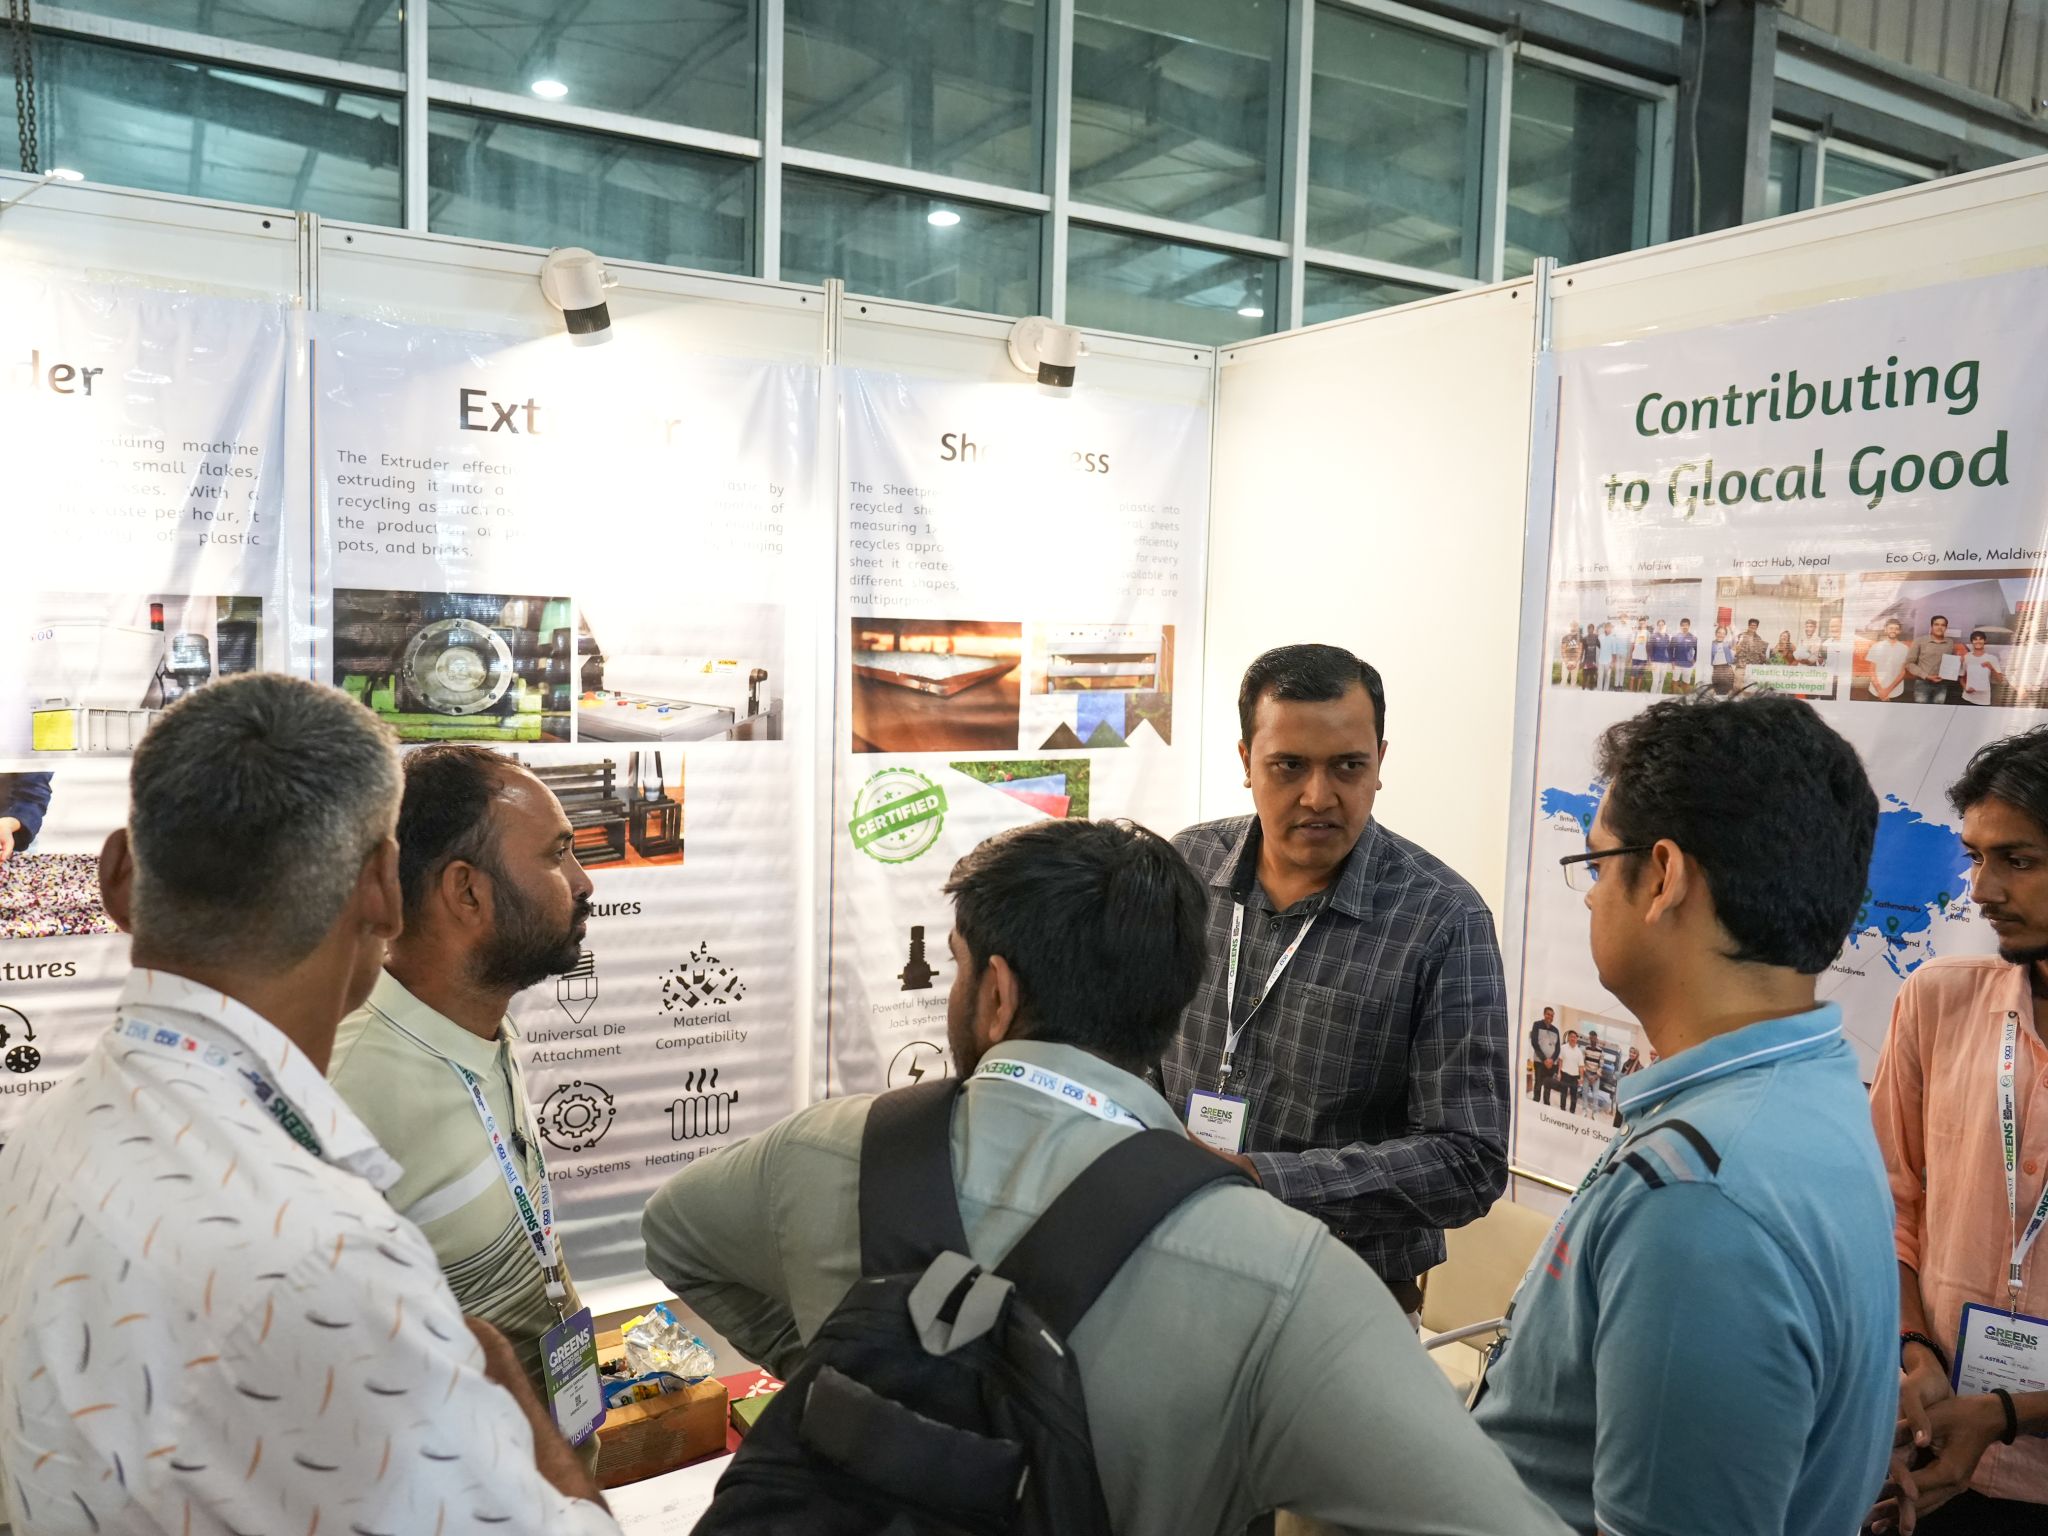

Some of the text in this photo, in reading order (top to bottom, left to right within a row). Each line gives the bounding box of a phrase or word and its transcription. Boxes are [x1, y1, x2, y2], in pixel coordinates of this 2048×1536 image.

[1635, 355, 1980, 437] Contributing
[183, 440, 259, 456] machine
[337, 450, 367, 464] The
[381, 454, 450, 471] Extruder
[132, 459, 187, 475] small
[199, 461, 259, 481] flakes,
[1604, 429, 2010, 521] to Glocal Good
[337, 474, 415, 493] extruding
[428, 479, 439, 492] it
[769, 483, 784, 497] by
[850, 482, 873, 494] The
[337, 496, 411, 514] recycling
[418, 503, 437, 513] as
[771, 503, 784, 514] of
[850, 502, 903, 515] recycled
[1161, 503, 1180, 515] into
[192, 506, 240, 525] hour,
[337, 516, 365, 530] the
[850, 521, 917, 536] measuring
[1150, 519, 1180, 532] sheets
[198, 526, 261, 547] plastic
[337, 540, 379, 555] pots,
[385, 543, 415, 555] and
[850, 539, 900, 552] recycles
[850, 558, 884, 568] sheet
[891, 559, 900, 569] it
[1136, 552, 1179, 565] for every
[1771, 556, 1795, 569] Hub,
[1799, 555, 1830, 567] Nepal
[1886, 547, 2047, 565] Eco Org, Male, Maldives
[850, 575, 903, 587] different
[1169, 571, 1179, 581] in
[1161, 588, 1178, 598] are
[1798, 684, 1825, 692] Nepal
[856, 795, 940, 839] CERTIFIED
[590, 900, 642, 917] tures
[1874, 900, 1921, 913] Kathmandu
[1951, 903, 1971, 914] South
[1886, 936, 1920, 948] Thailand
[1229, 938, 1239, 978] GREENS
[0, 961, 77, 981] tures
[1831, 964, 1866, 977] Maldives
[872, 998, 913, 1014] Powerful
[673, 1011, 731, 1028] Material
[888, 1015, 909, 1029] Jack
[526, 1023, 626, 1043] Universal Die
[655, 1029, 748, 1050] Compatibility
[531, 1044, 622, 1064] Attachment
[1028, 1070, 1058, 1090] SALT
[1200, 1106, 1233, 1120] GREENS
[1539, 1112, 1580, 1134] University
[1581, 1127, 1591, 1137] of
[2003, 1122, 2014, 1172] GREENS
[645, 1150, 694, 1166] Heating
[504, 1161, 518, 1183] SALT
[576, 1160, 631, 1178] Systems
[513, 1185, 539, 1232] GREENS
[1985, 1325, 2038, 1346] GREENS
[548, 1327, 590, 1368] GREENS
[1984, 1355, 2008, 1366] ASTRAL
[570, 1421, 593, 1446] VISITOR
